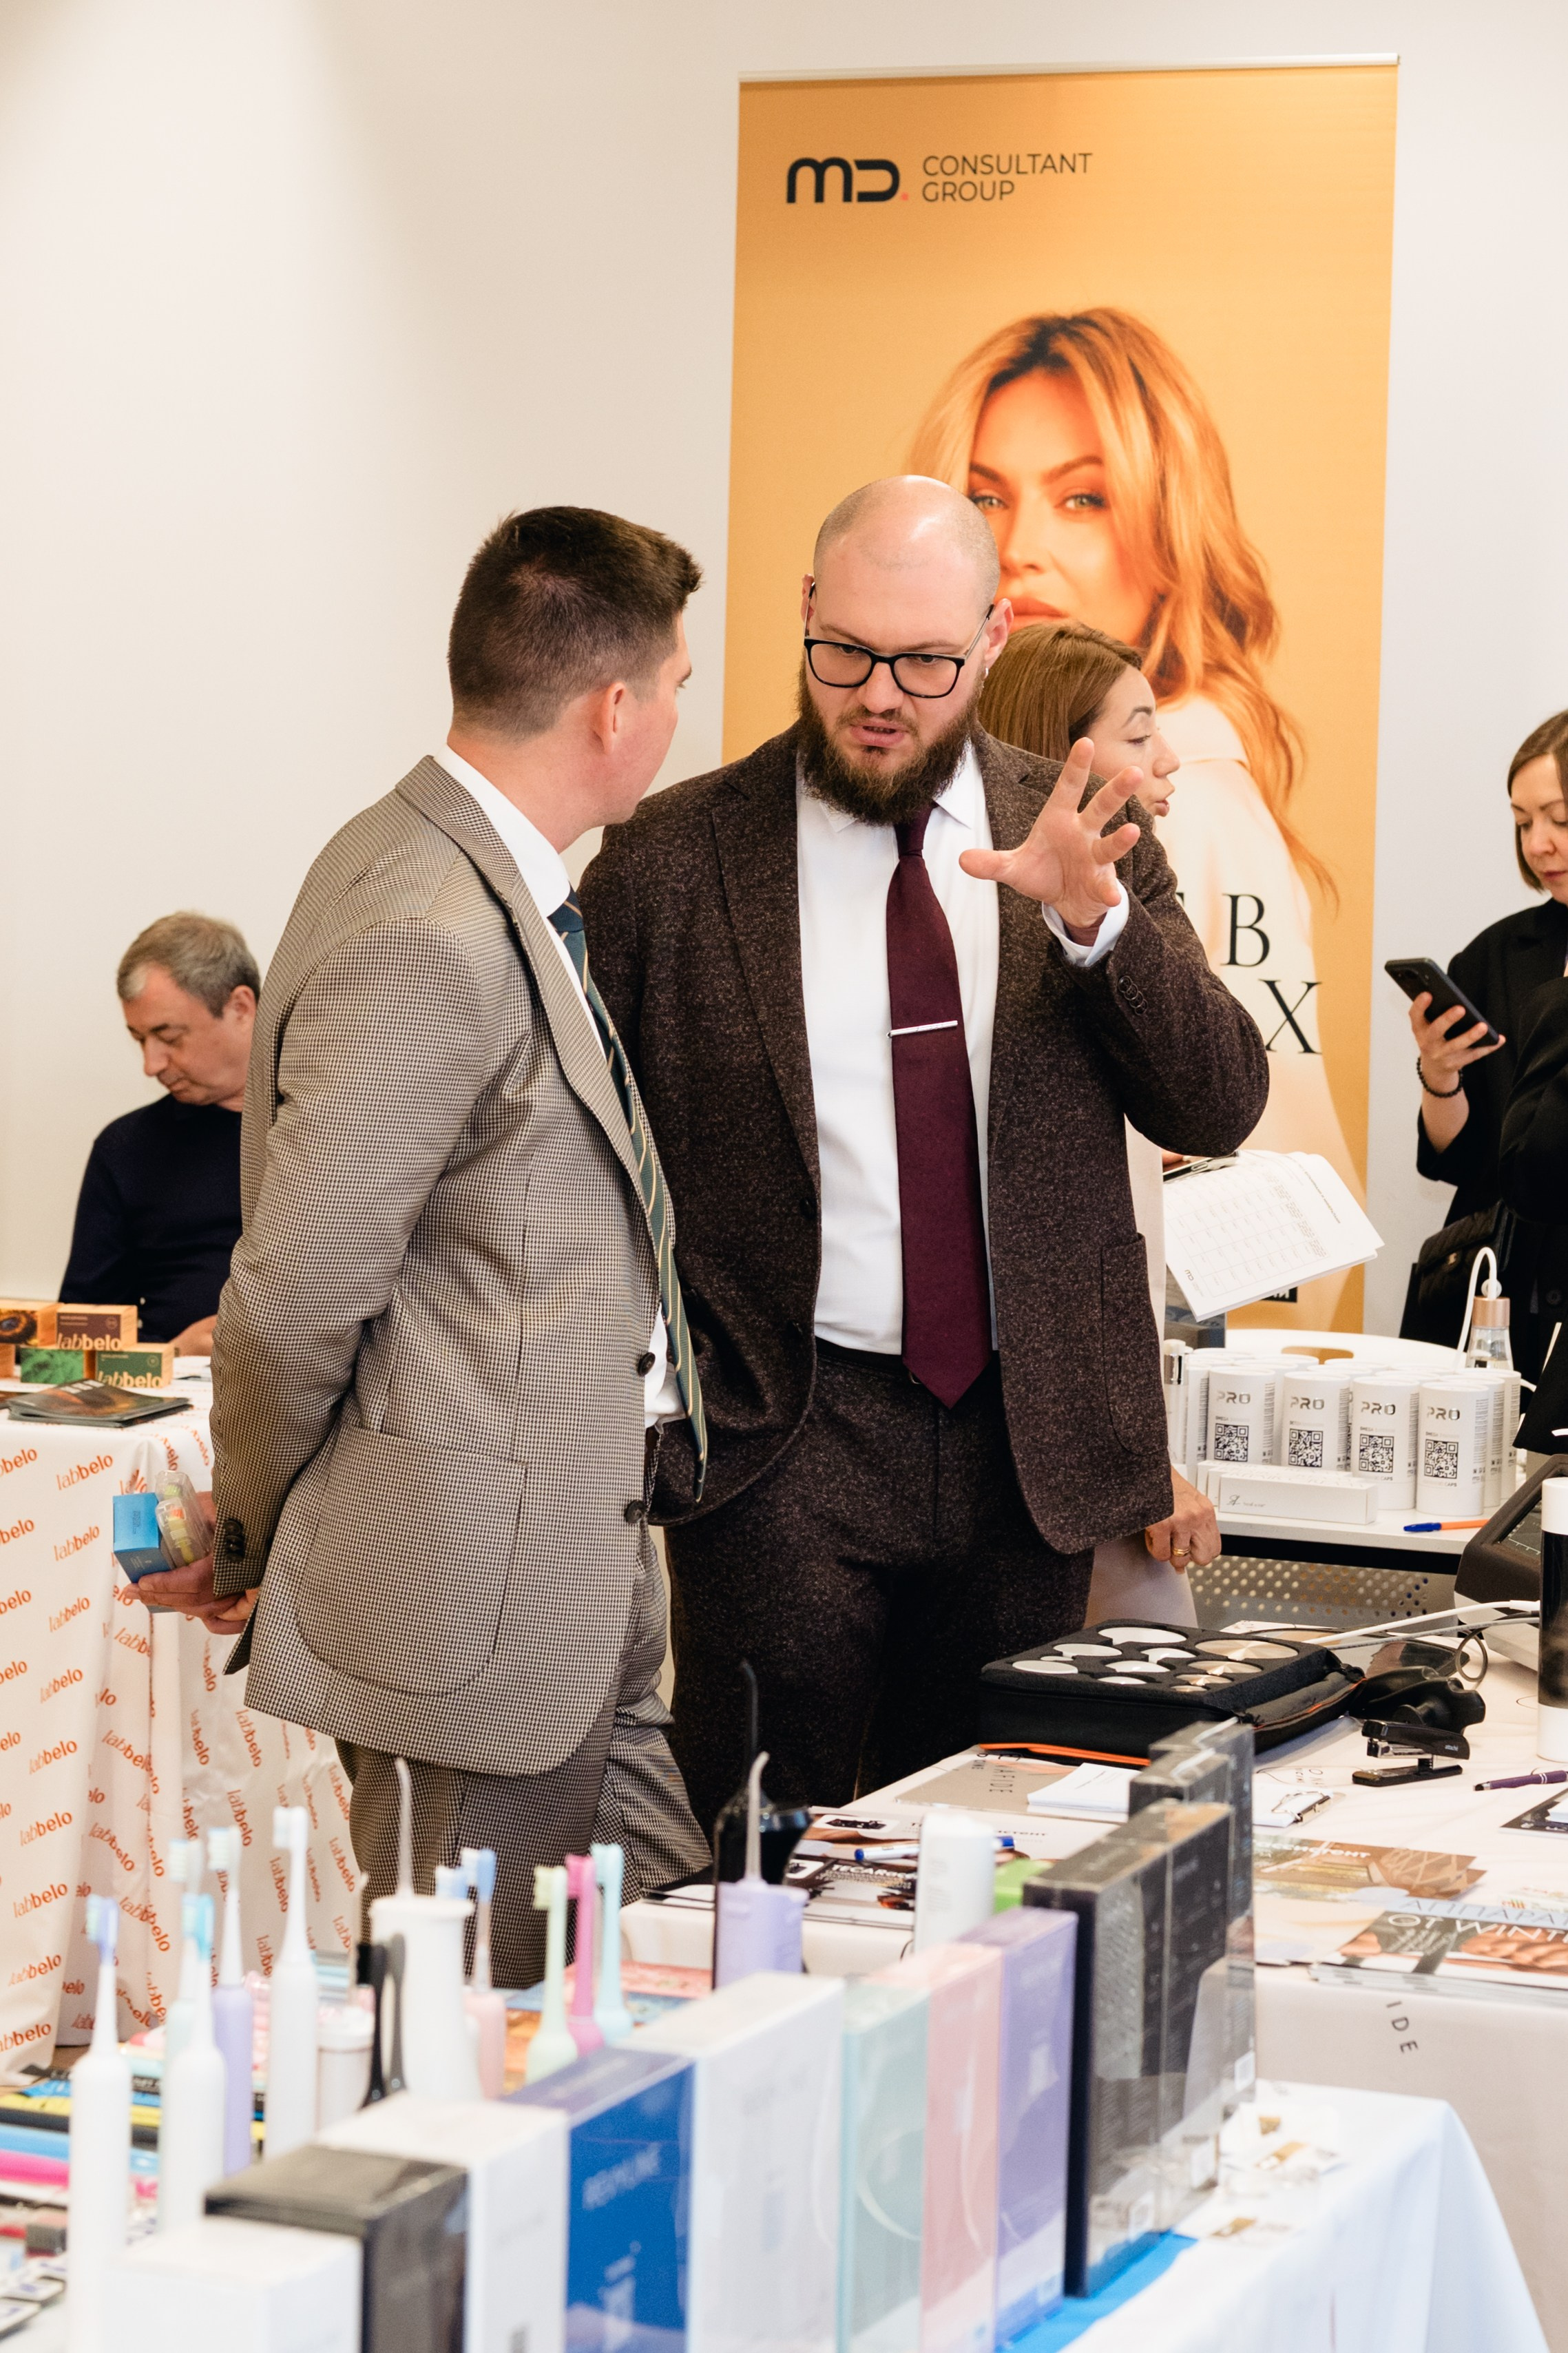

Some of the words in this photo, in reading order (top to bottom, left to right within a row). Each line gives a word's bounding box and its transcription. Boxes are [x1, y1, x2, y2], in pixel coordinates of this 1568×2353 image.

[922, 153, 1093, 177] CONSULTANT
[922, 180, 1015, 203] GROUP
[56, 1334, 121, 1351] labbelo
[1217, 1390, 1251, 1404] PRO
[1290, 1396, 1324, 1410] PRO
[1361, 1401, 1396, 1416] PRO
[1427, 1407, 1460, 1421] PRO
[56, 1455, 113, 1491] labbelo
[54, 1526, 99, 1562] labbelo
[49, 1597, 90, 1632] labbelo
[236, 1709, 262, 1768] labbelo
[29, 1741, 77, 1775] labbelo
[19, 1812, 72, 1847] labbelo
[13, 1883, 67, 1918] labbelo
[8, 1954, 62, 1987] labbelo
